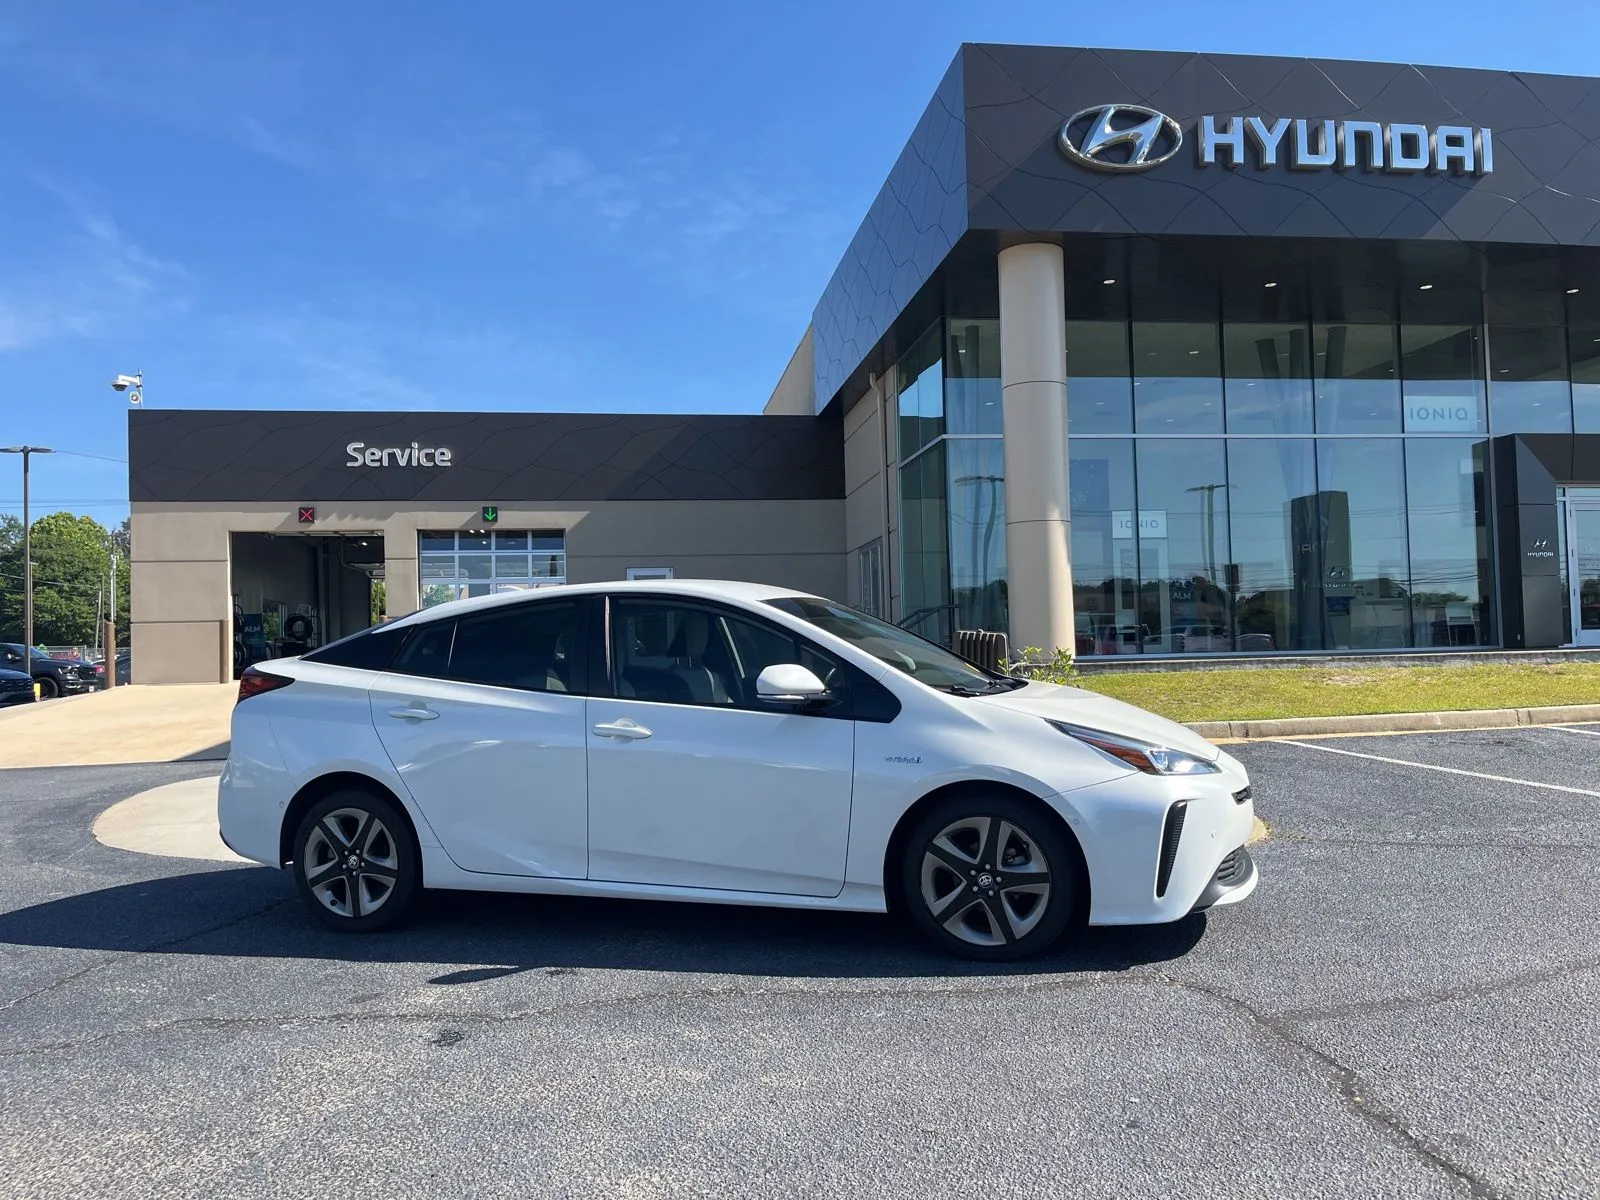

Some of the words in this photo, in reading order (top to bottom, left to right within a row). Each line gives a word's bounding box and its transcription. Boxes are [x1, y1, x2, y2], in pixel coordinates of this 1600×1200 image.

[1200, 115, 1494, 174] HYUNDAI
[1410, 407, 1468, 421] IONIQ
[346, 441, 451, 467] Service
